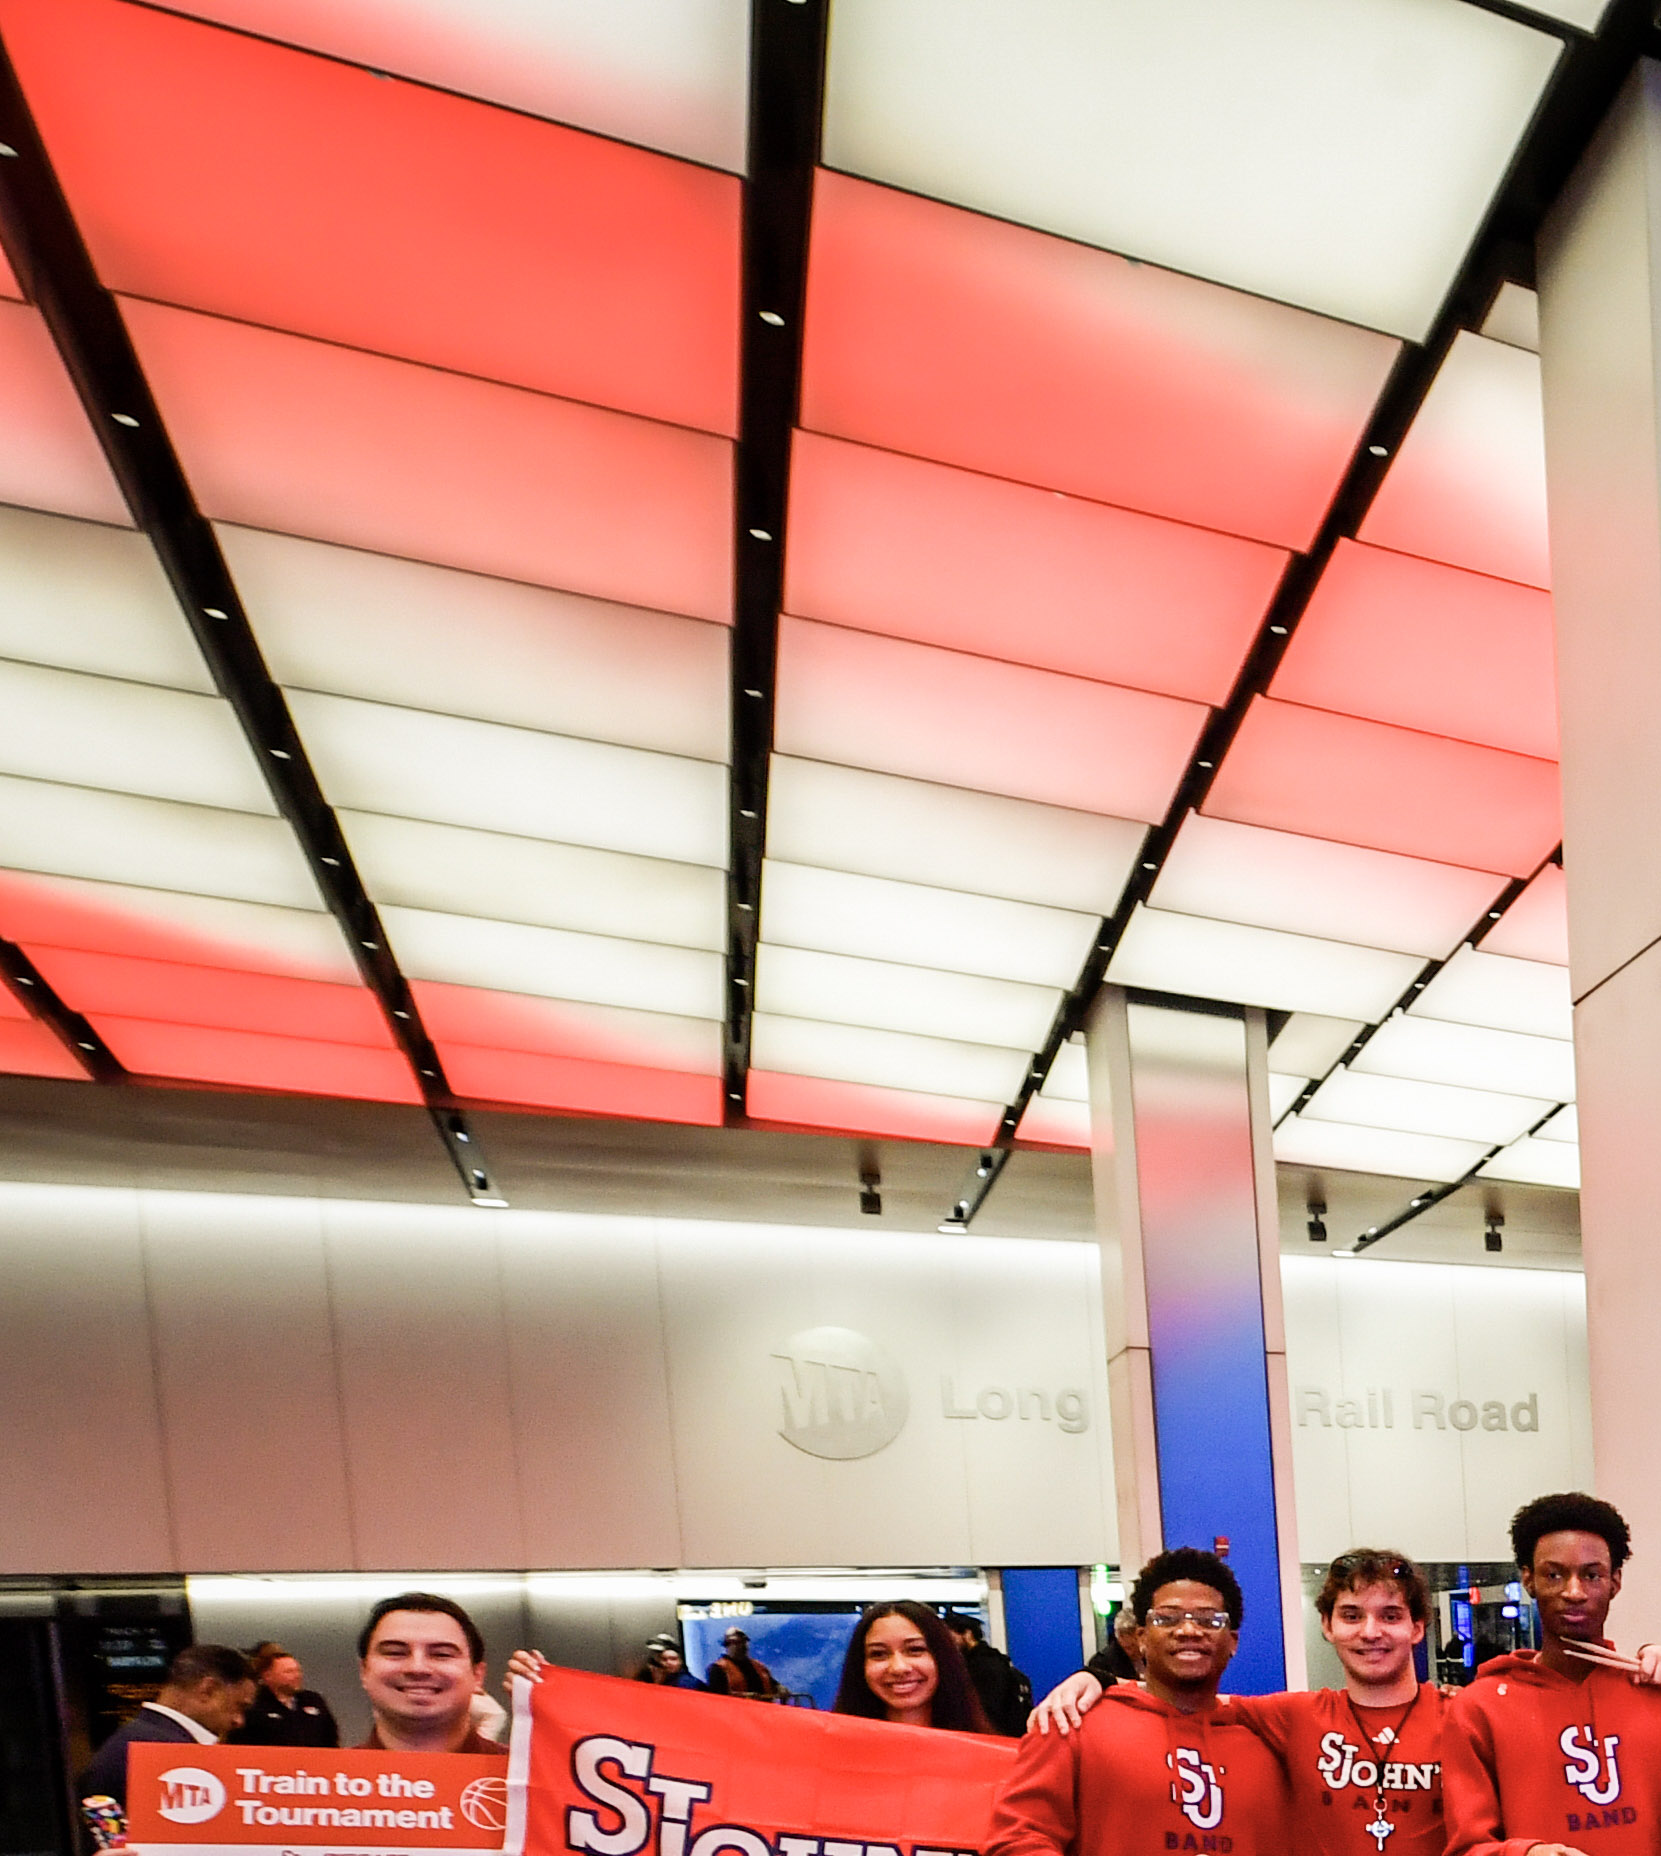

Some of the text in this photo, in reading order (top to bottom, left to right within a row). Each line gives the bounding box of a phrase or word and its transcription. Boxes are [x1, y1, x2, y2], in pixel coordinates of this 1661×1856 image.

[940, 1373, 1541, 1434] Long Rail Road
[159, 1778, 212, 1812] MTA
[235, 1768, 436, 1799] Train to the
[234, 1799, 454, 1830] Tournament
[1565, 1805, 1638, 1832] BAND
[1164, 1831, 1233, 1854] BAND
